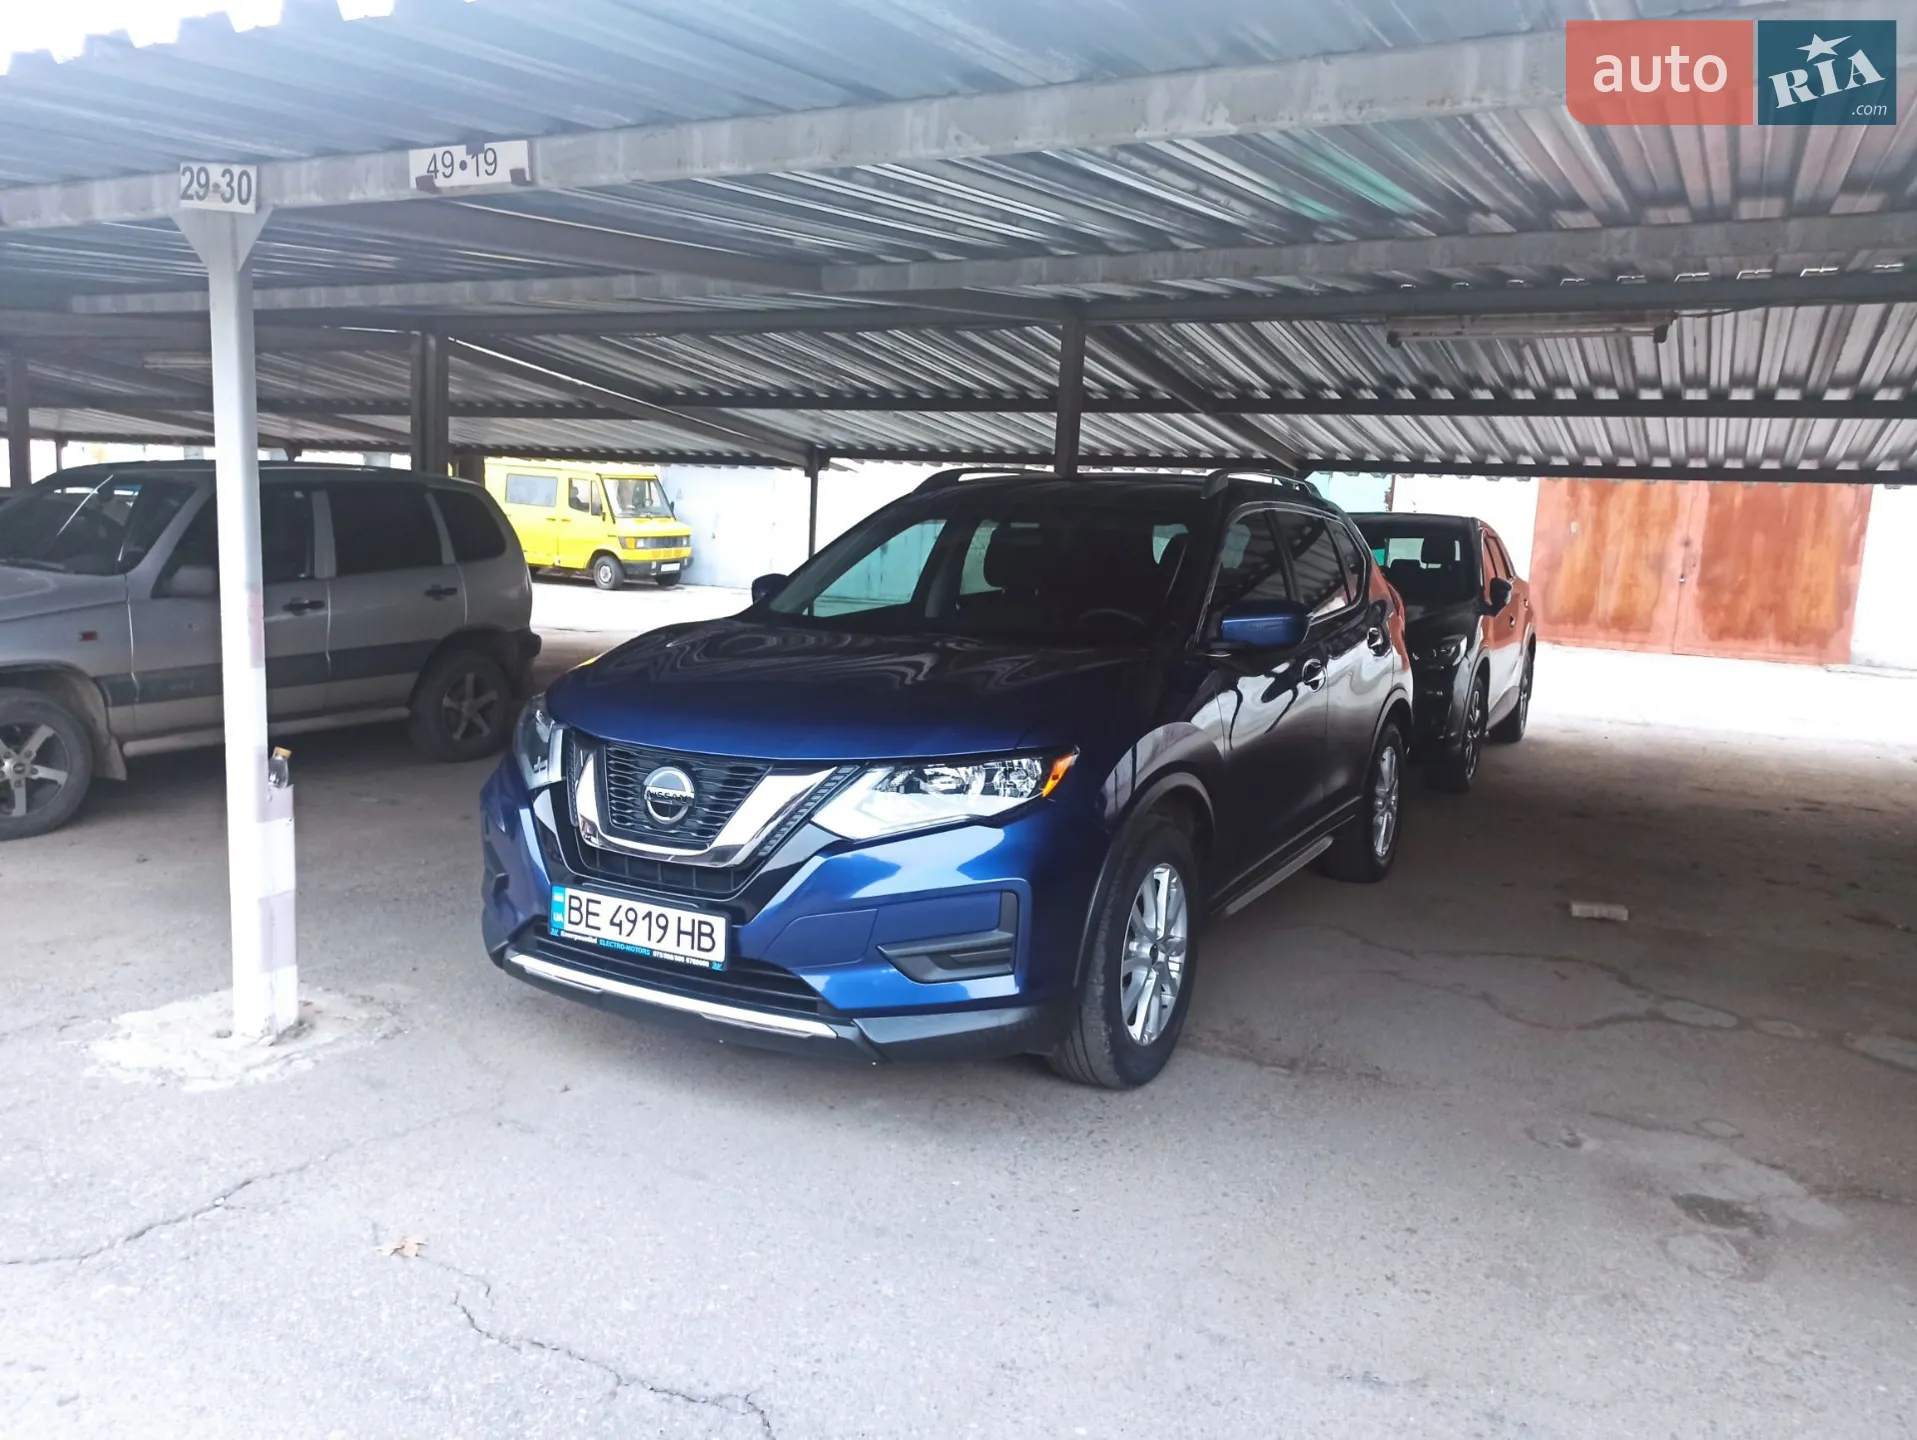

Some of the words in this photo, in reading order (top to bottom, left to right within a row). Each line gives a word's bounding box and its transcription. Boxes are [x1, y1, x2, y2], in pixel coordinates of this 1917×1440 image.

[647, 790, 688, 802] NISSAN
[568, 895, 601, 931] BE
[609, 905, 670, 943] 4919
[676, 916, 717, 953] HB
